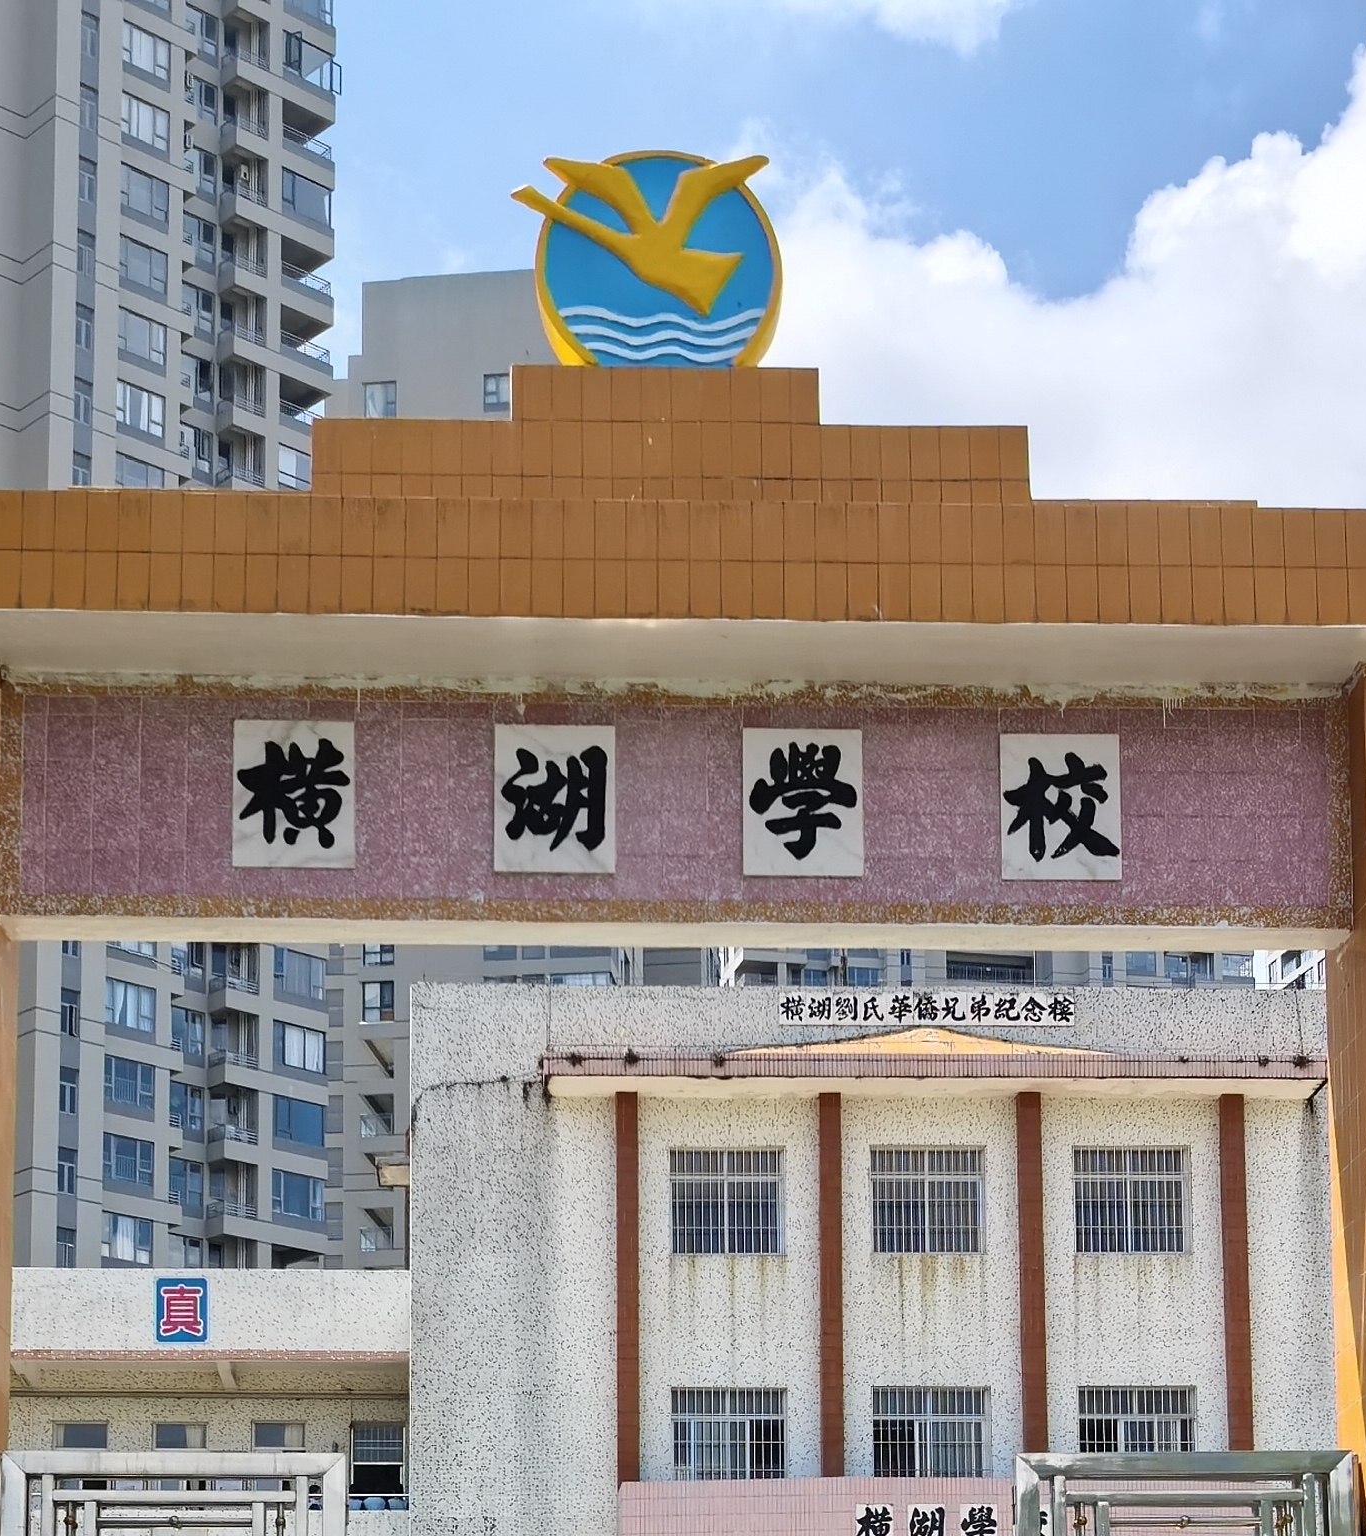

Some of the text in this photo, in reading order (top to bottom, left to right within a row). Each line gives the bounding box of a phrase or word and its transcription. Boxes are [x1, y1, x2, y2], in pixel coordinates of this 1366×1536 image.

[236, 739, 1120, 861] 横湖學校
[161, 1284, 203, 1336] 真
